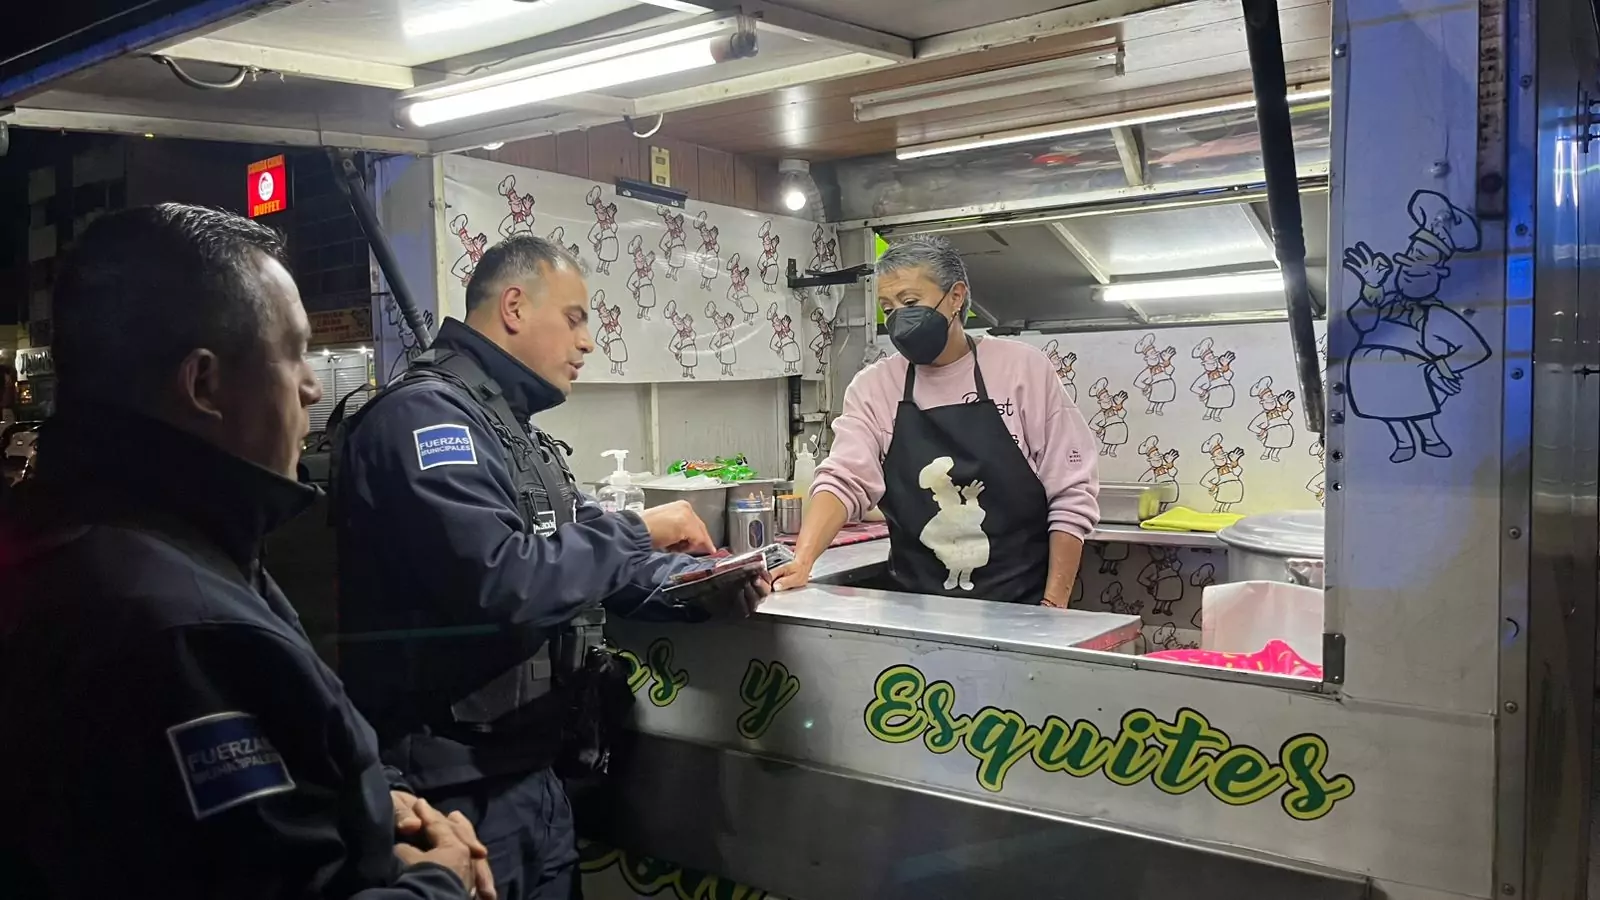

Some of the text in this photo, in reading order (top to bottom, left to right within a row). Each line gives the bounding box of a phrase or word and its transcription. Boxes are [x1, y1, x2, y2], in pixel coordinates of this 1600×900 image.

[254, 200, 280, 217] BUFFET
[419, 436, 470, 451] FUERZAS
[421, 445, 471, 457] MUNICIPALES
[737, 658, 800, 739] y
[864, 664, 1355, 820] Esquites
